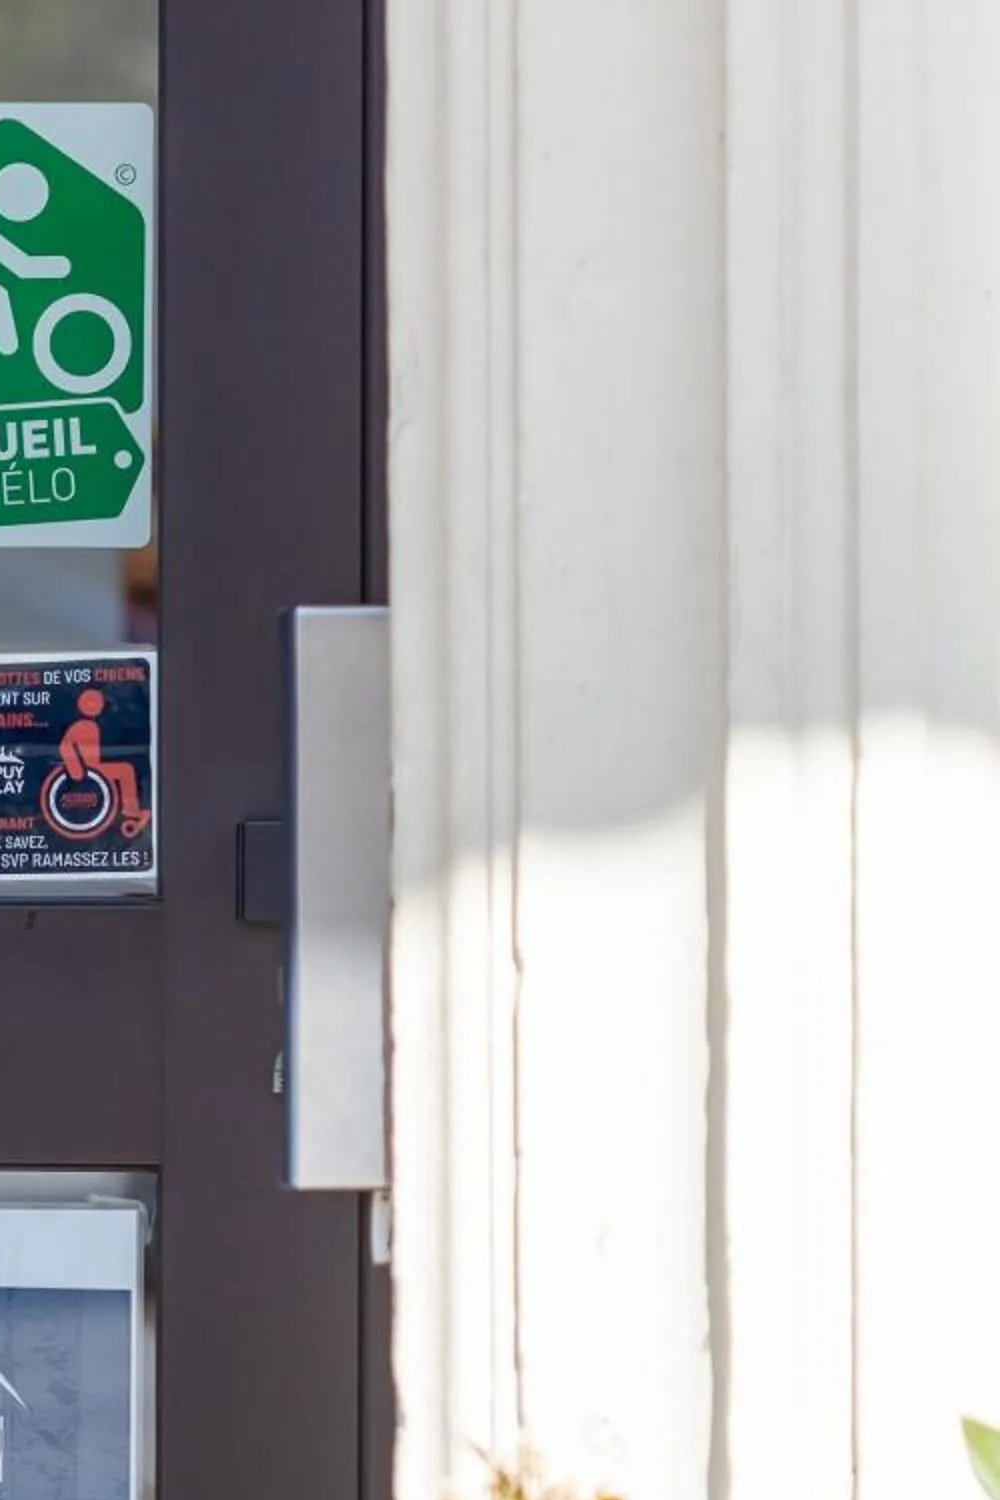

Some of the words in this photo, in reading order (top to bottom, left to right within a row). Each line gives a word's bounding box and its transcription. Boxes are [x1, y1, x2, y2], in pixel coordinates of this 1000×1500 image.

[43, 670, 61, 685] DE
[63, 669, 91, 684] VOS
[94, 666, 145, 682] CHIENS
[23, 691, 51, 706] SUR
[1, 852, 29, 868] SVP
[32, 851, 109, 867] RAMASSEZ
[112, 851, 140, 866] LES
